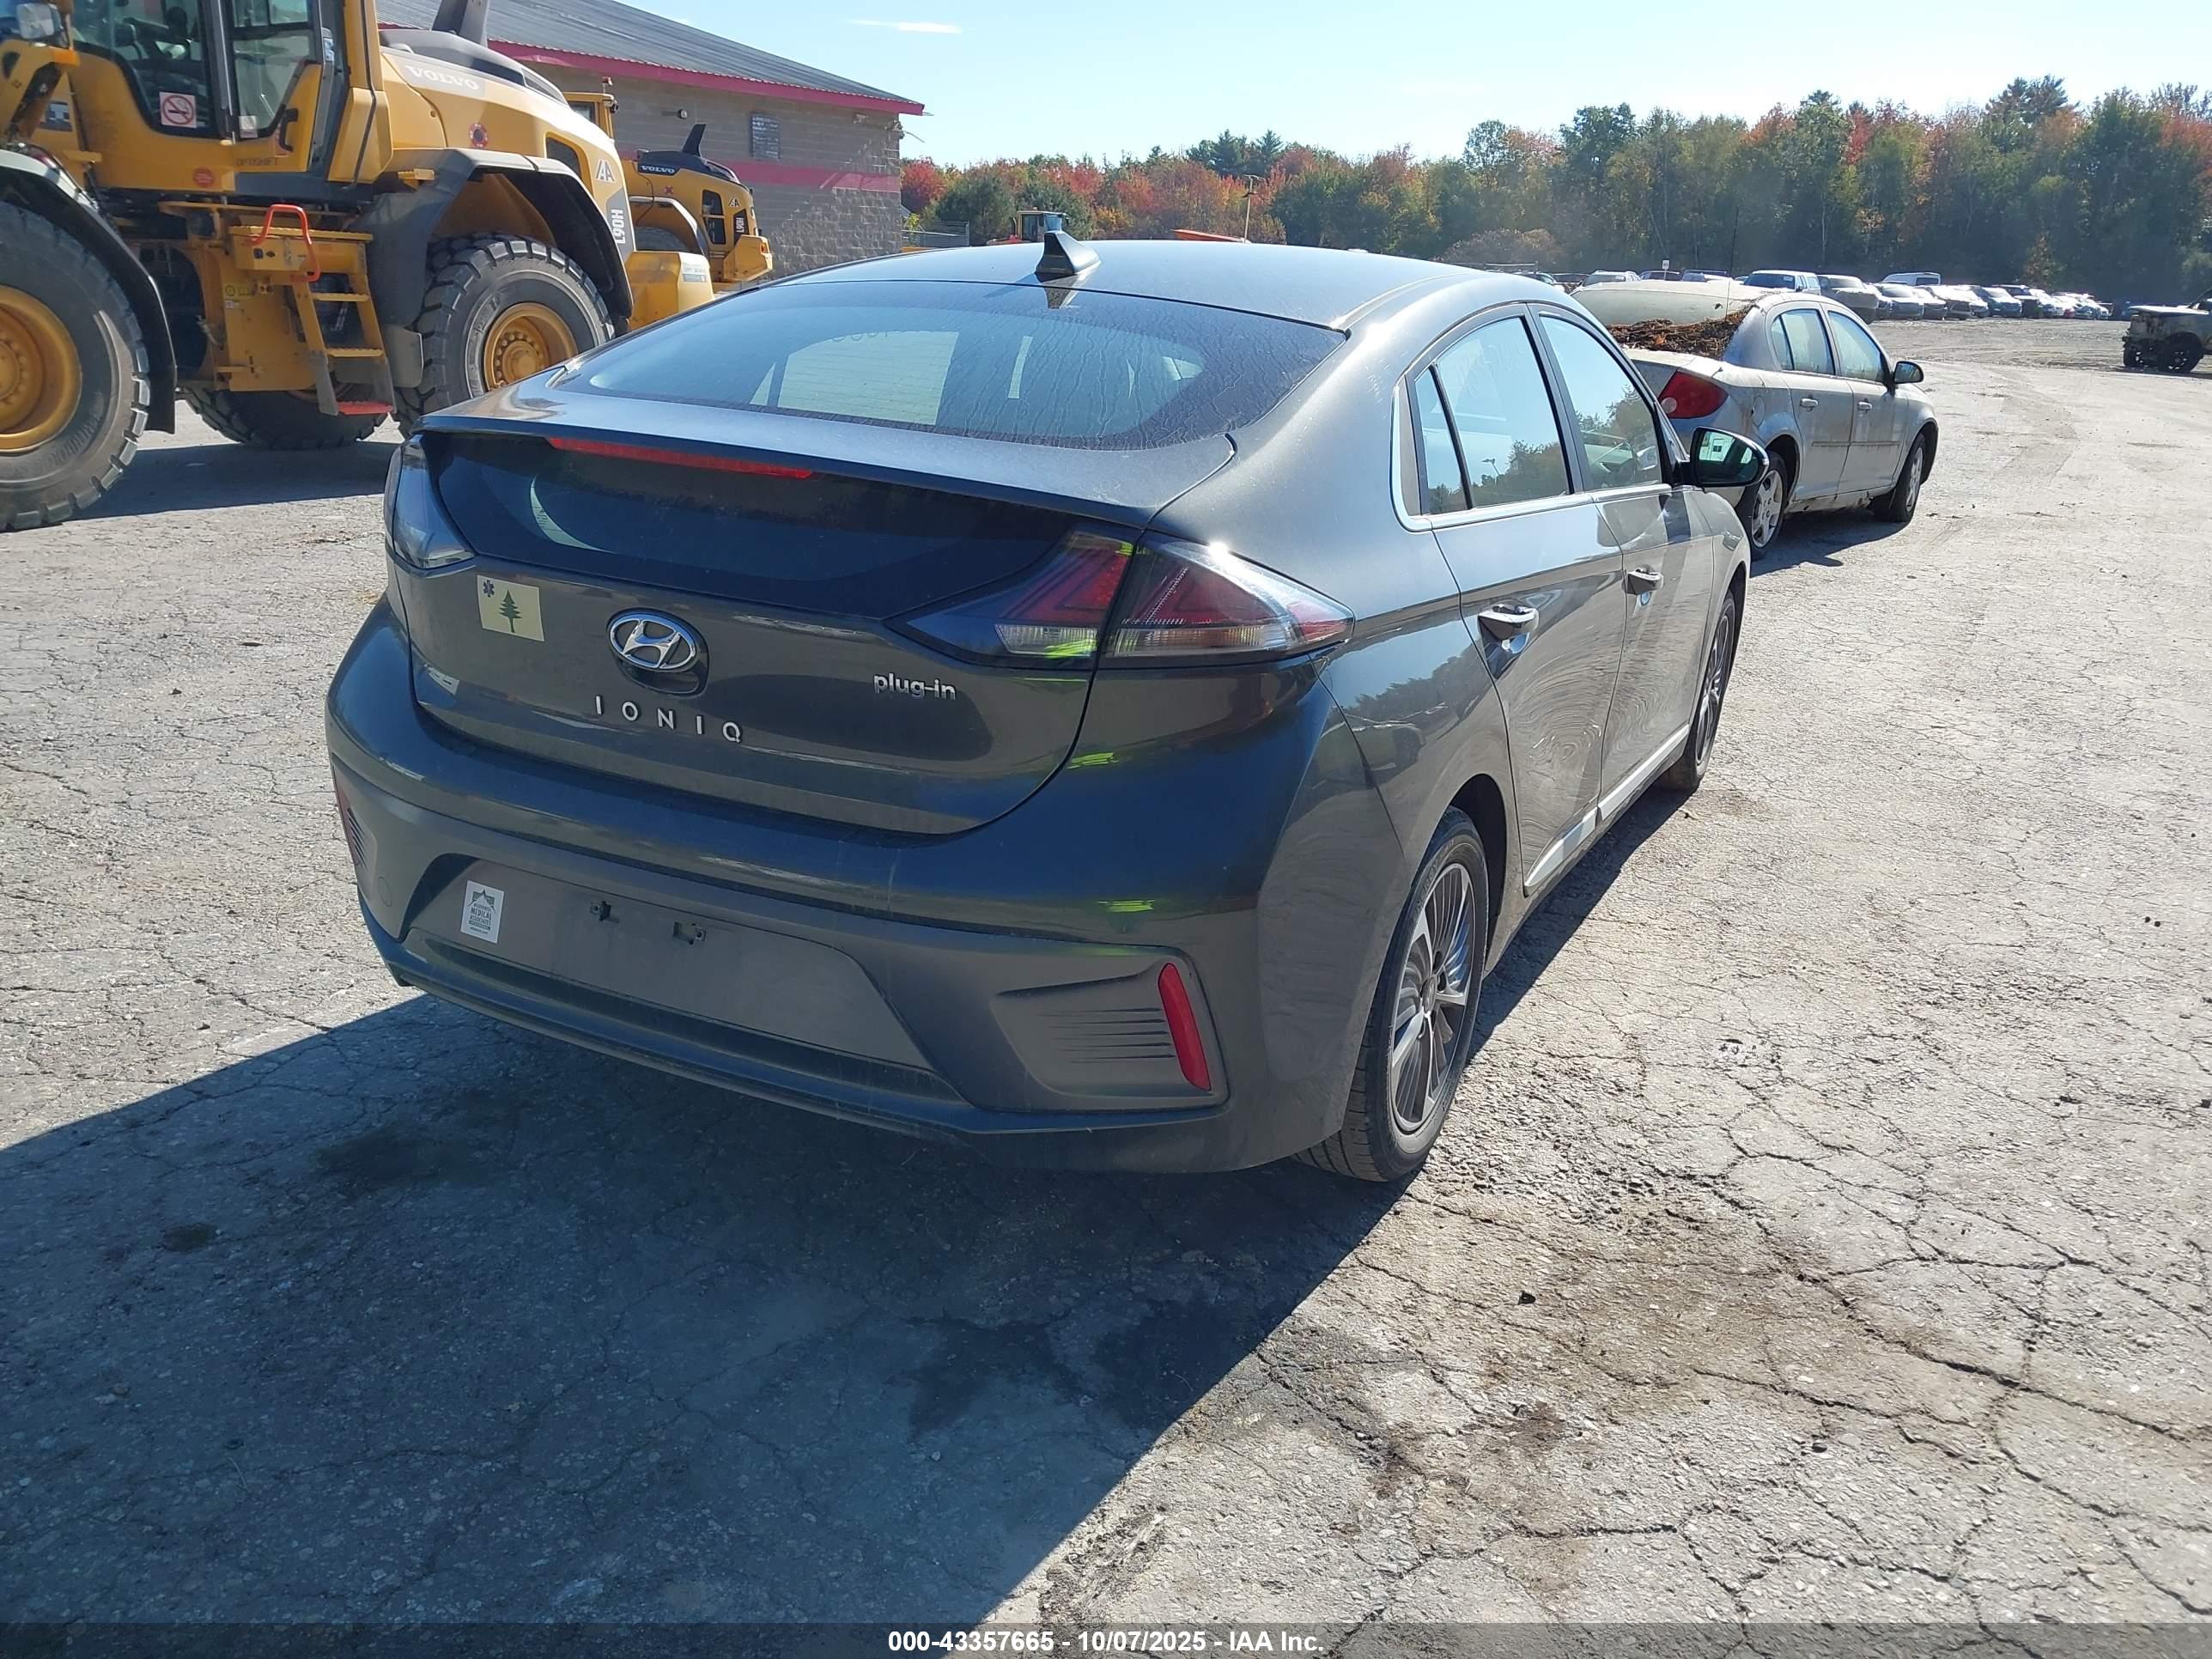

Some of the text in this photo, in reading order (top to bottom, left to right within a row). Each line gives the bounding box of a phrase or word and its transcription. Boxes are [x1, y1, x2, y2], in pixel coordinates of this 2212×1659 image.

[404, 65, 480, 90] VOLVO
[640, 165, 675, 174] VOLVO
[611, 209, 626, 245] L90H
[873, 672, 956, 701] plug-in
[595, 695, 742, 743] IONIQ
[471, 906, 492, 921] MEDICAL
